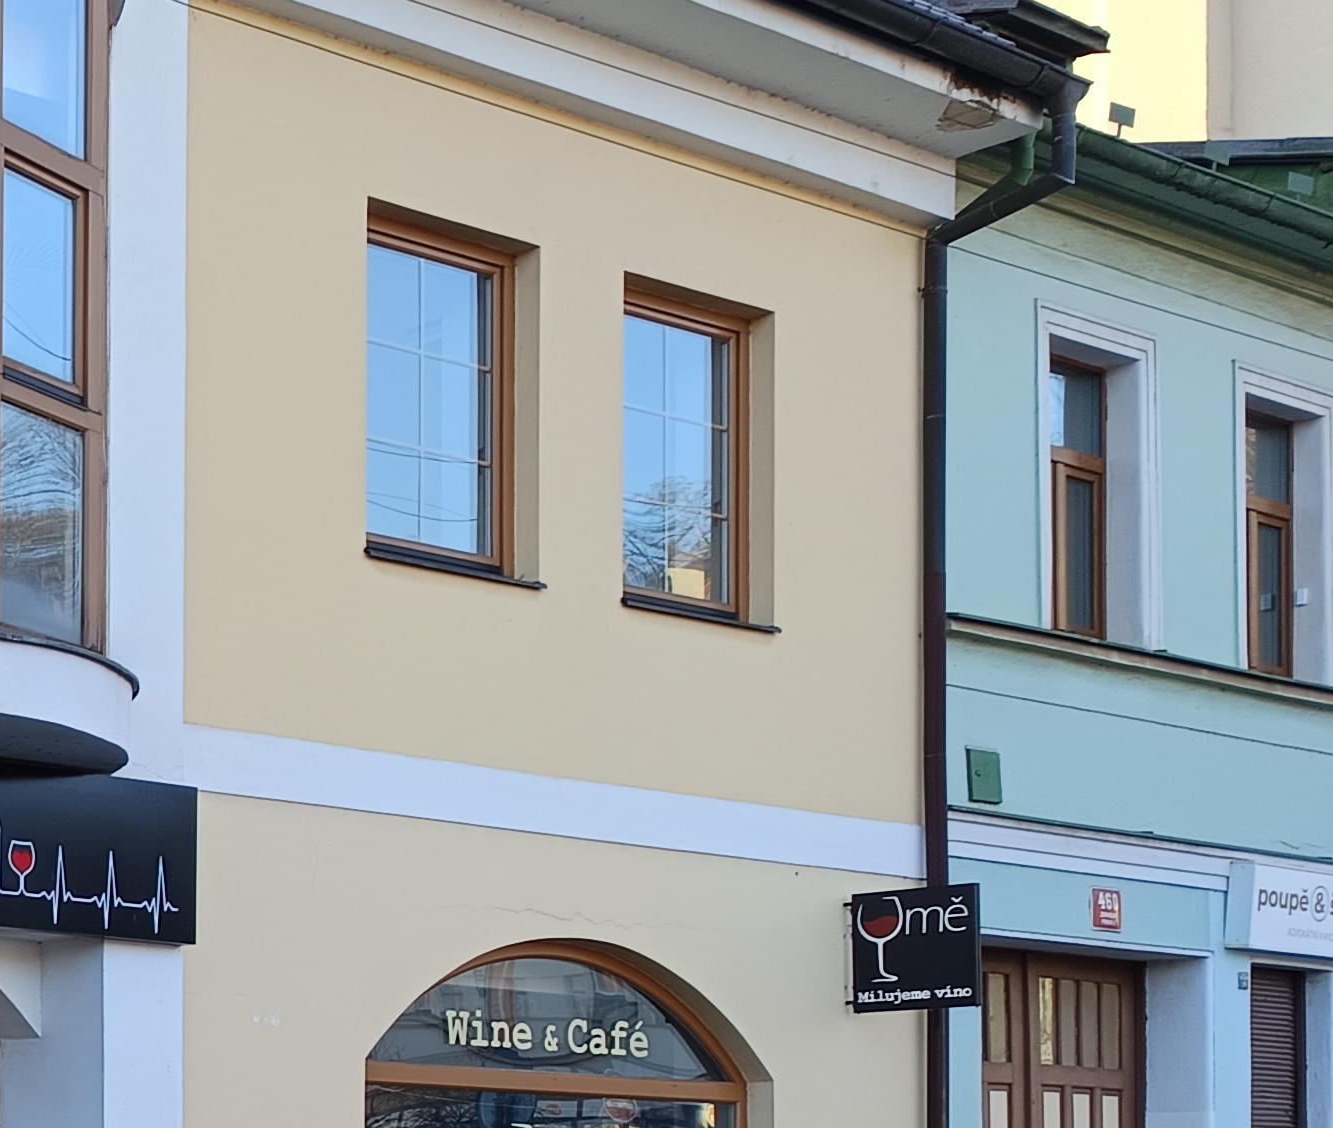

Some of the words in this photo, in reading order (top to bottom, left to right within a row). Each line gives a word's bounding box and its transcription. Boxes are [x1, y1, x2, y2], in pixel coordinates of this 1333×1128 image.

[1098, 891, 1119, 912] 460
[1257, 888, 1309, 916] poupě
[857, 988, 931, 1004] Milujeme
[934, 985, 973, 999] víno
[445, 1008, 533, 1050] Wine
[544, 1024, 559, 1053] &
[567, 1018, 650, 1058] Café
